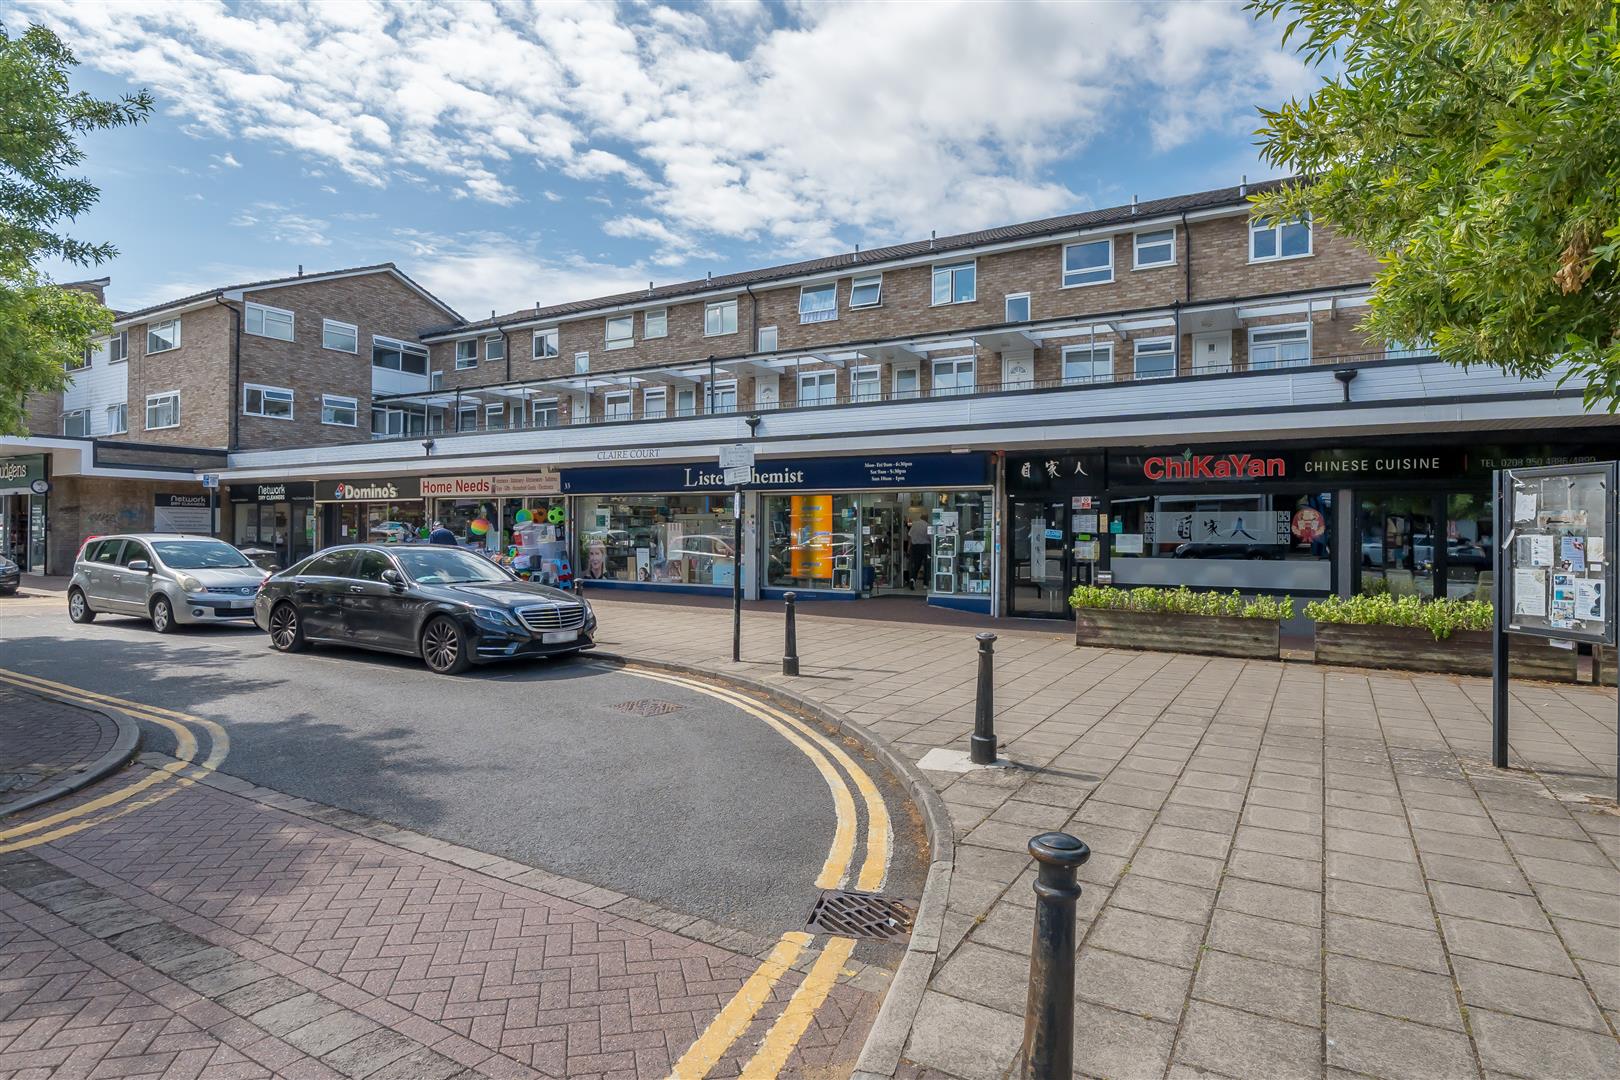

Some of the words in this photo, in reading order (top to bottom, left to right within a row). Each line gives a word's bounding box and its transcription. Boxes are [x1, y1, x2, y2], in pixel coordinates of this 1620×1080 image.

[597, 450, 629, 460] CLAIRE
[630, 448, 662, 459] COURT
[0, 463, 27, 481] udgens
[1143, 453, 1286, 480] ChiKaYan
[1304, 460, 1369, 472] CHINESE
[1375, 457, 1440, 470] CUISINE
[422, 480, 453, 493] Home
[455, 478, 490, 492] Needs
[684, 468, 725, 487] Liste
[751, 468, 804, 484] hemist
[345, 482, 399, 499] Domino's
